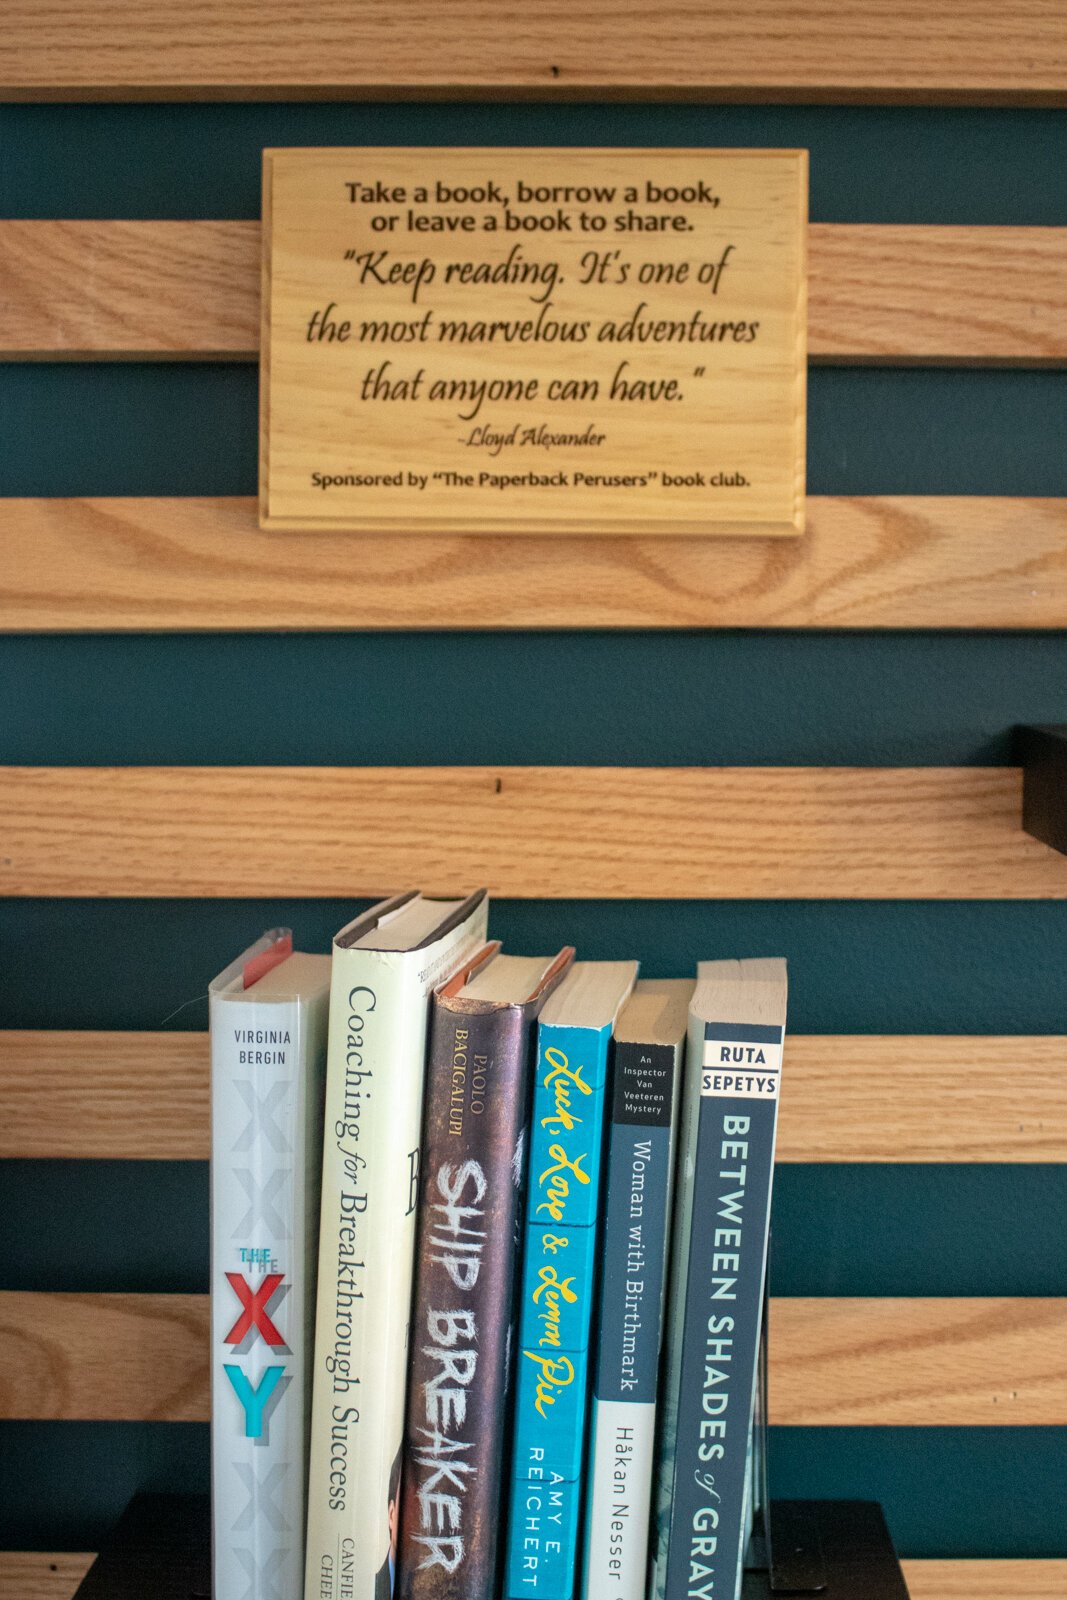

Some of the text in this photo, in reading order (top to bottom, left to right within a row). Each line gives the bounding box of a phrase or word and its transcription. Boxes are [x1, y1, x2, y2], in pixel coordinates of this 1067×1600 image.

[345, 180, 721, 209] Take a book, borrow a book,
[370, 209, 694, 232] or leave a book to share.
[343, 243, 736, 304] "Keep reading. It's one of
[306, 301, 760, 343] the most marvelous adventures
[360, 360, 426, 401] that
[428, 379, 539, 421] anyone
[547, 379, 599, 401] can
[519, 423, 606, 450] Alexander
[311, 471, 751, 491] Sponsored by “The Paperback Perusers” book club.
[234, 1029, 291, 1045] VIRGINIA
[239, 1051, 286, 1065] BERGIN
[624, 1066, 667, 1077] Inspector
[640, 1055, 652, 1064] An
[719, 1046, 767, 1065] RUTA
[448, 1028, 469, 1137] BACIGALUPI
[470, 1054, 488, 1115] PAOLO
[540, 1046, 593, 1135] Luck,
[623, 1090, 665, 1101] Veeteren
[636, 1079, 653, 1088] Van
[702, 1074, 777, 1093] SEPETYS
[625, 1103, 662, 1115] Mystery
[536, 1143, 591, 1221] Love
[239, 1247, 271, 1263] THE
[325, 985, 378, 1512] Coaching for Breakthrough Success
[542, 1233, 570, 1255] &
[620, 1139, 652, 1392] Woman with Birthmark
[411, 1158, 489, 1575] SHIP BREAKER
[687, 1114, 751, 1600] BETWEEN SHADES of GRAY
[522, 1350, 575, 1420] Pie
[522, 1447, 545, 1587] REICHERT
[544, 1471, 566, 1564] AMY E.
[608, 1426, 634, 1580] Håkan Nesser
